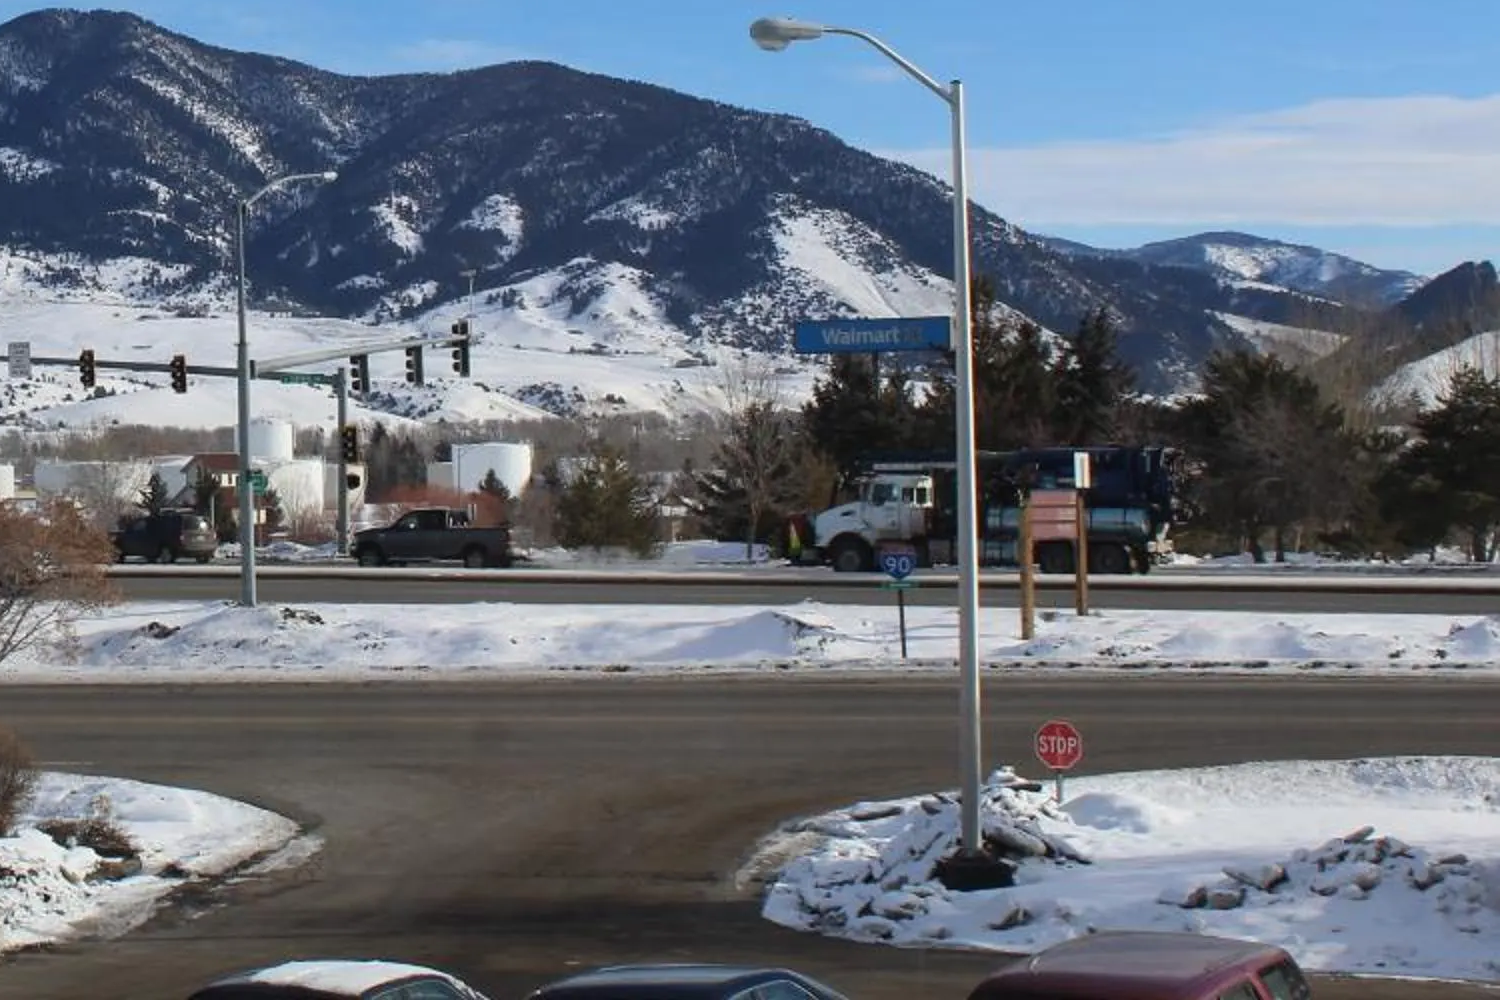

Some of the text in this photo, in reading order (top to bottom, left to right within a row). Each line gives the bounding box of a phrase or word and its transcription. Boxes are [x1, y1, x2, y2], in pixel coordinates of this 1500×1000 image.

[821, 325, 900, 345] Walmart
[885, 555, 910, 573] 90
[1039, 735, 1077, 753] STOP
